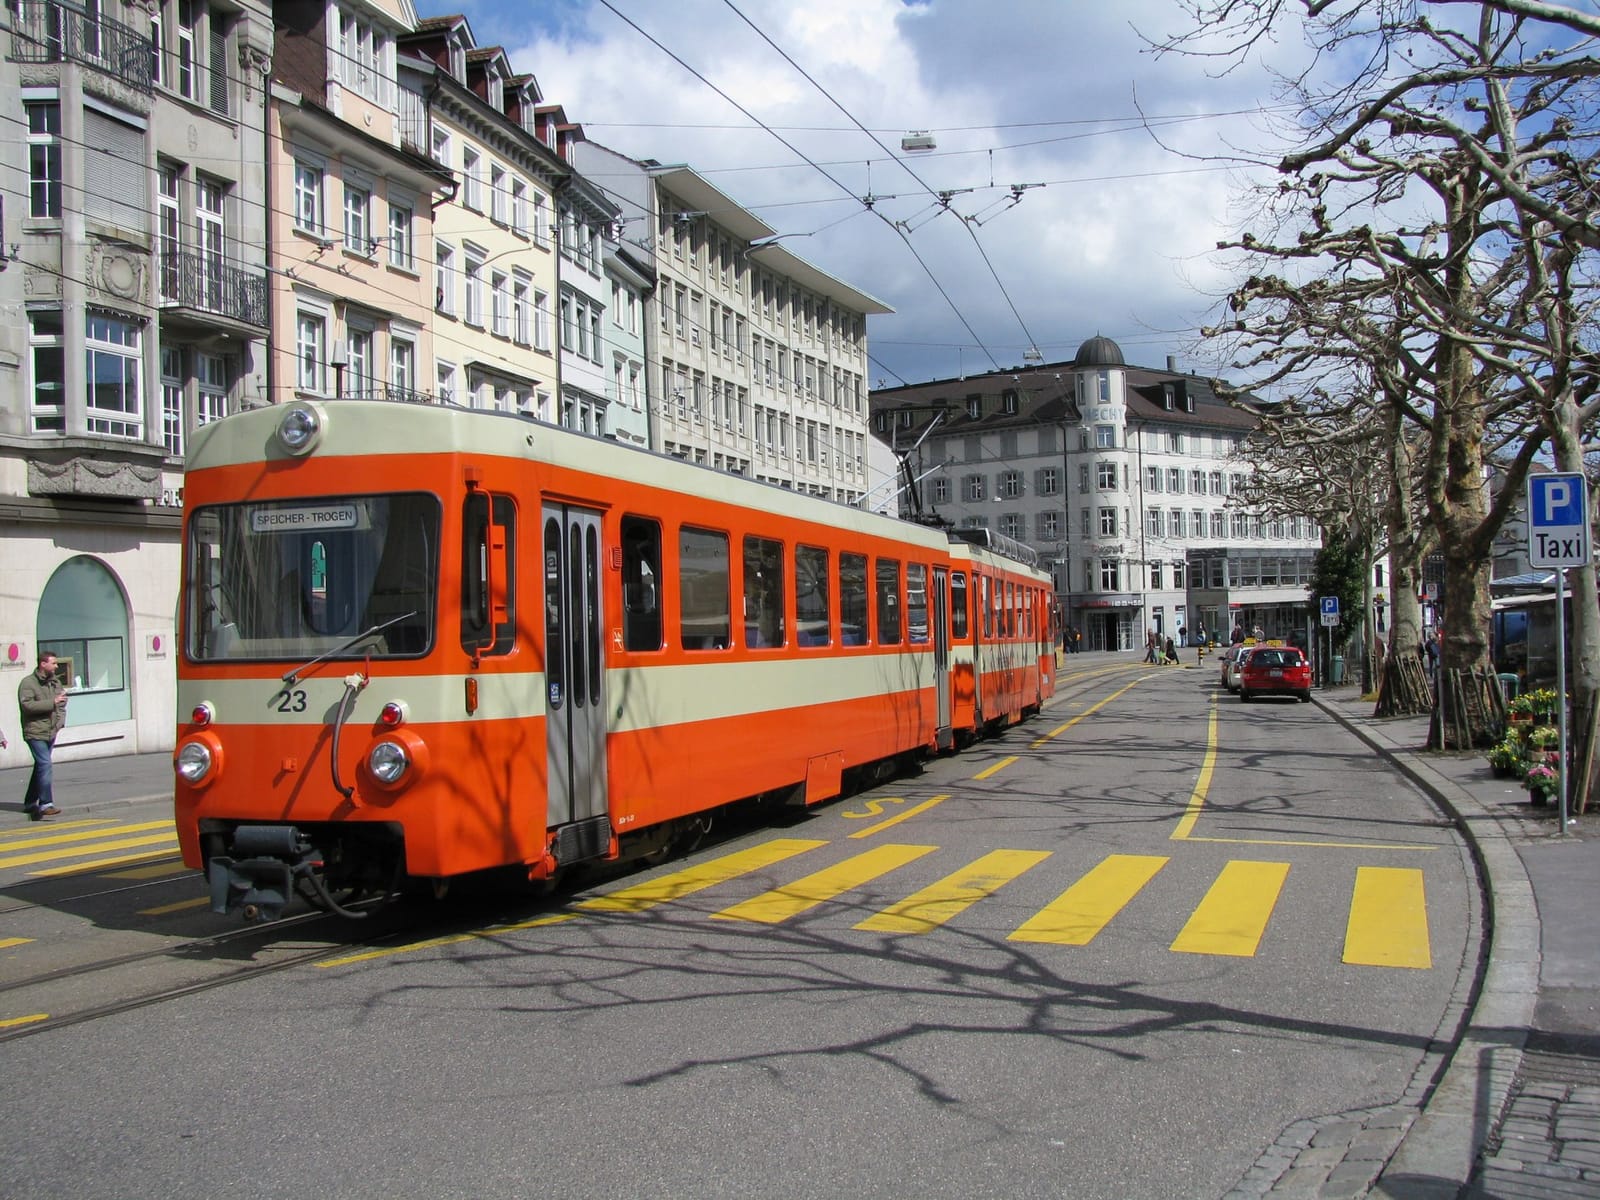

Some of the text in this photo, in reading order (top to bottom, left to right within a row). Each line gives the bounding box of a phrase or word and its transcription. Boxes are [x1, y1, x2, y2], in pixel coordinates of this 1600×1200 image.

[1084, 407, 1124, 421] HECHT
[1544, 482, 1570, 520] P
[257, 513, 305, 525] SPEICHER
[312, 511, 353, 523] TROGEN
[1536, 533, 1580, 558] Taxi
[1325, 599, 1334, 612] P
[1322, 614, 1339, 625] Taxi
[278, 690, 307, 712] 23
